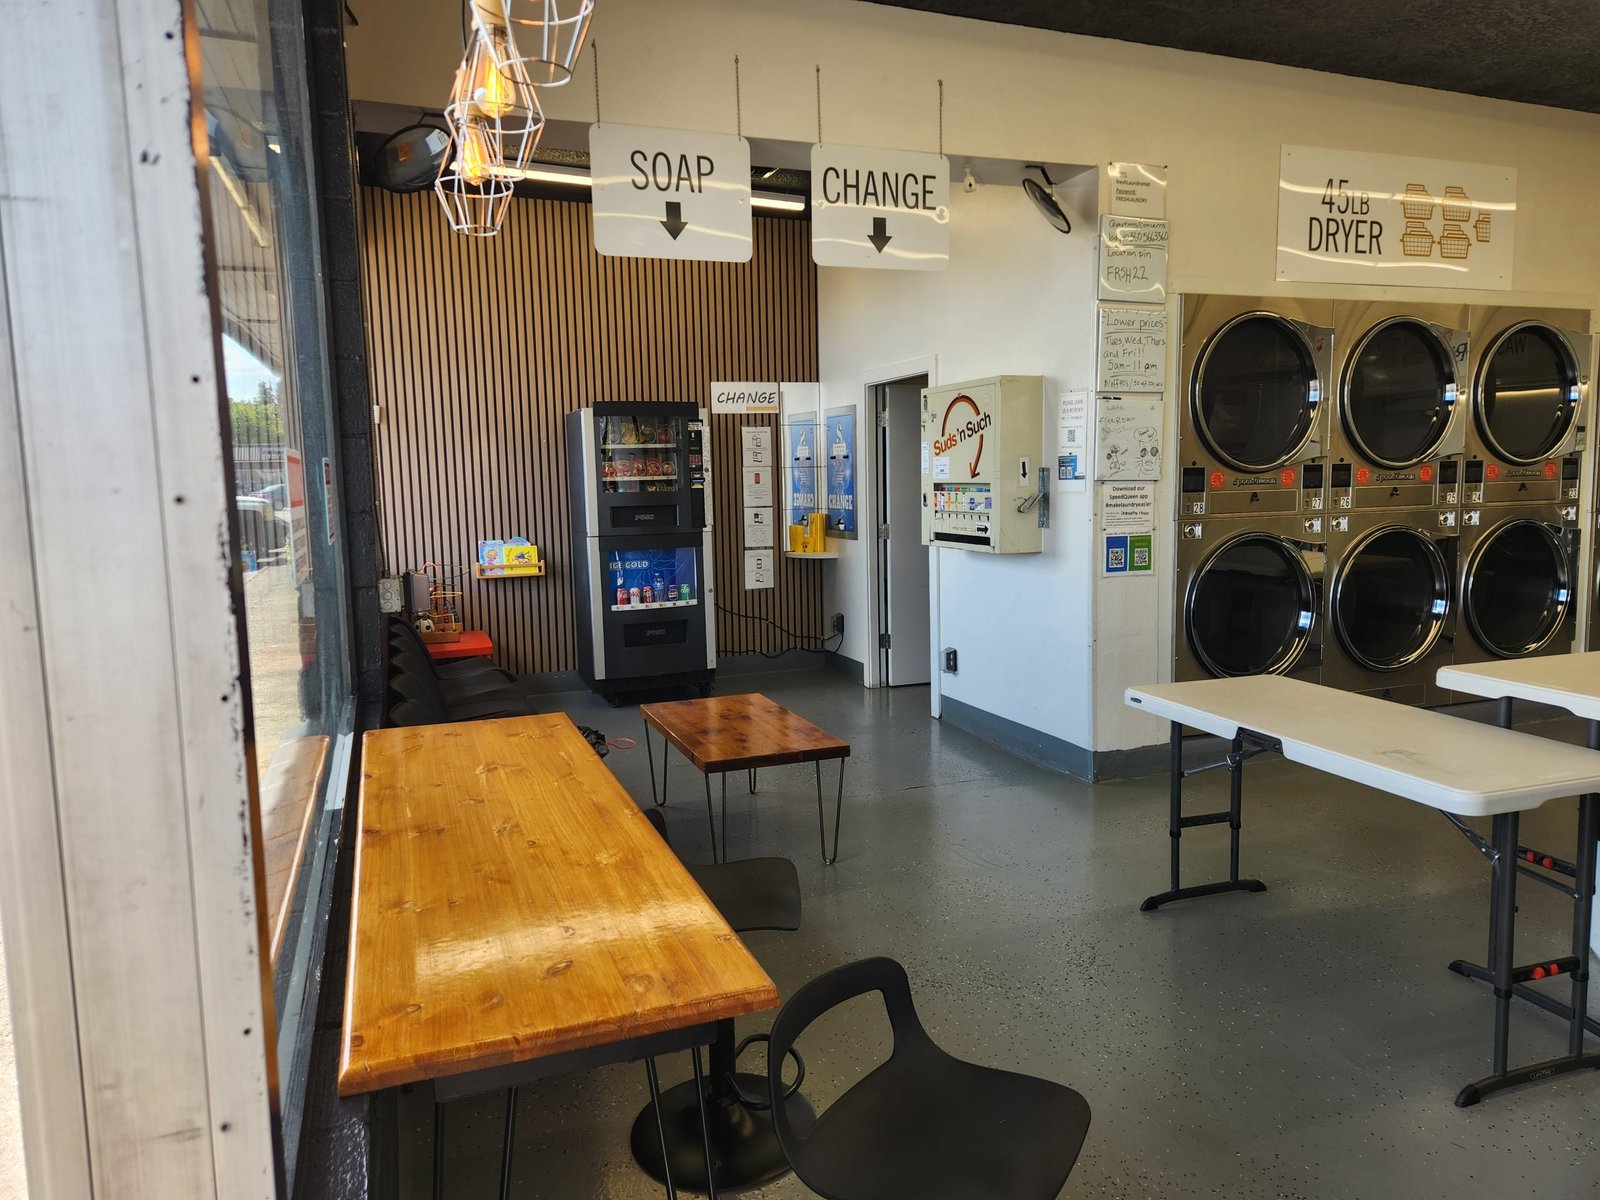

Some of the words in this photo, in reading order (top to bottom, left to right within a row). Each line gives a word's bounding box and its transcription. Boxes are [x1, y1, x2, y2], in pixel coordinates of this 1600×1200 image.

[630, 149, 715, 193] SOAP
[822, 166, 937, 211] CHANGE
[1321, 178, 1370, 215] 45LB
[1308, 216, 1383, 255] DRYER
[1107, 248, 1136, 258] Location
[1138, 250, 1152, 258] pin
[1107, 265, 1149, 283] FRSH22
[1107, 313, 1135, 326] Lower
[1139, 319, 1164, 332] prices
[1103, 350, 1119, 359] and
[717, 391, 777, 404] CHANGE
[933, 433, 958, 456] Suds
[966, 412, 992, 438] Such
[829, 494, 853, 511] CHANGE
[1341, 497, 1350, 507] 26
[1447, 493, 1456, 503] 25
[1473, 492, 1481, 501] 24
[1194, 503, 1204, 513] 28
[1312, 498, 1321, 509] 27
[625, 561, 649, 569] COLD
